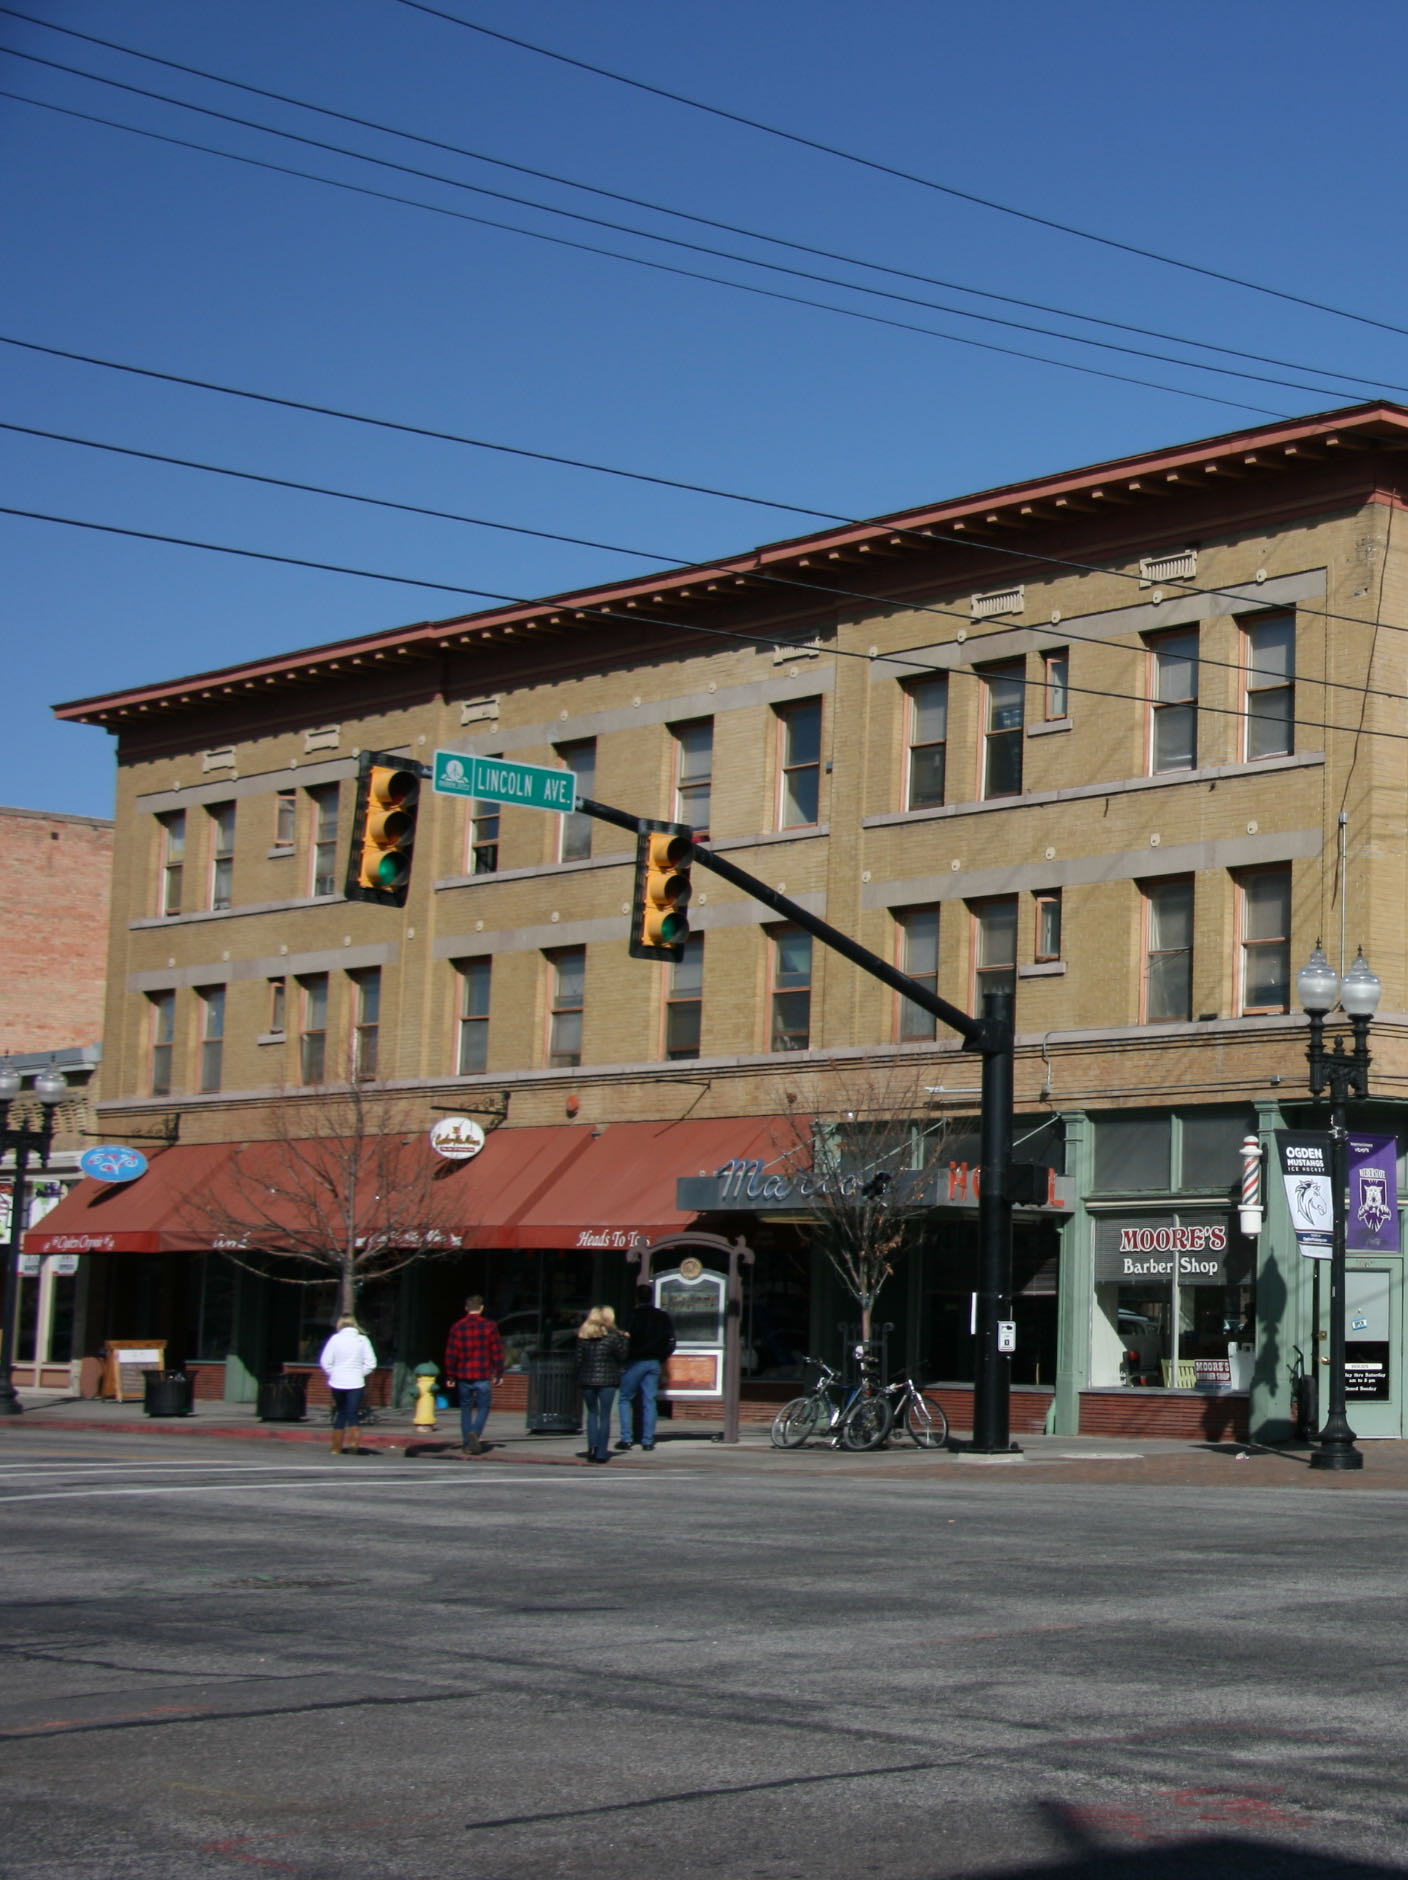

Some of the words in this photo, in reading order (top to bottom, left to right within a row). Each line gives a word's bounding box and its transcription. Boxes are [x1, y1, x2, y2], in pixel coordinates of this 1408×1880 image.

[477, 767, 533, 797] LINCOLN
[543, 778, 571, 804] AVE.
[1286, 1146, 1323, 1159] OGDEN
[1287, 1158, 1325, 1168] MUSTANGS
[576, 1229, 610, 1247] Heads
[612, 1230, 626, 1247] To
[1120, 1226, 1227, 1252] MOORE'S
[1123, 1258, 1173, 1274] Barber
[1180, 1257, 1218, 1276] Shop
[1195, 1361, 1230, 1372] MOORE'S
[1217, 1372, 1230, 1381] SHOP
